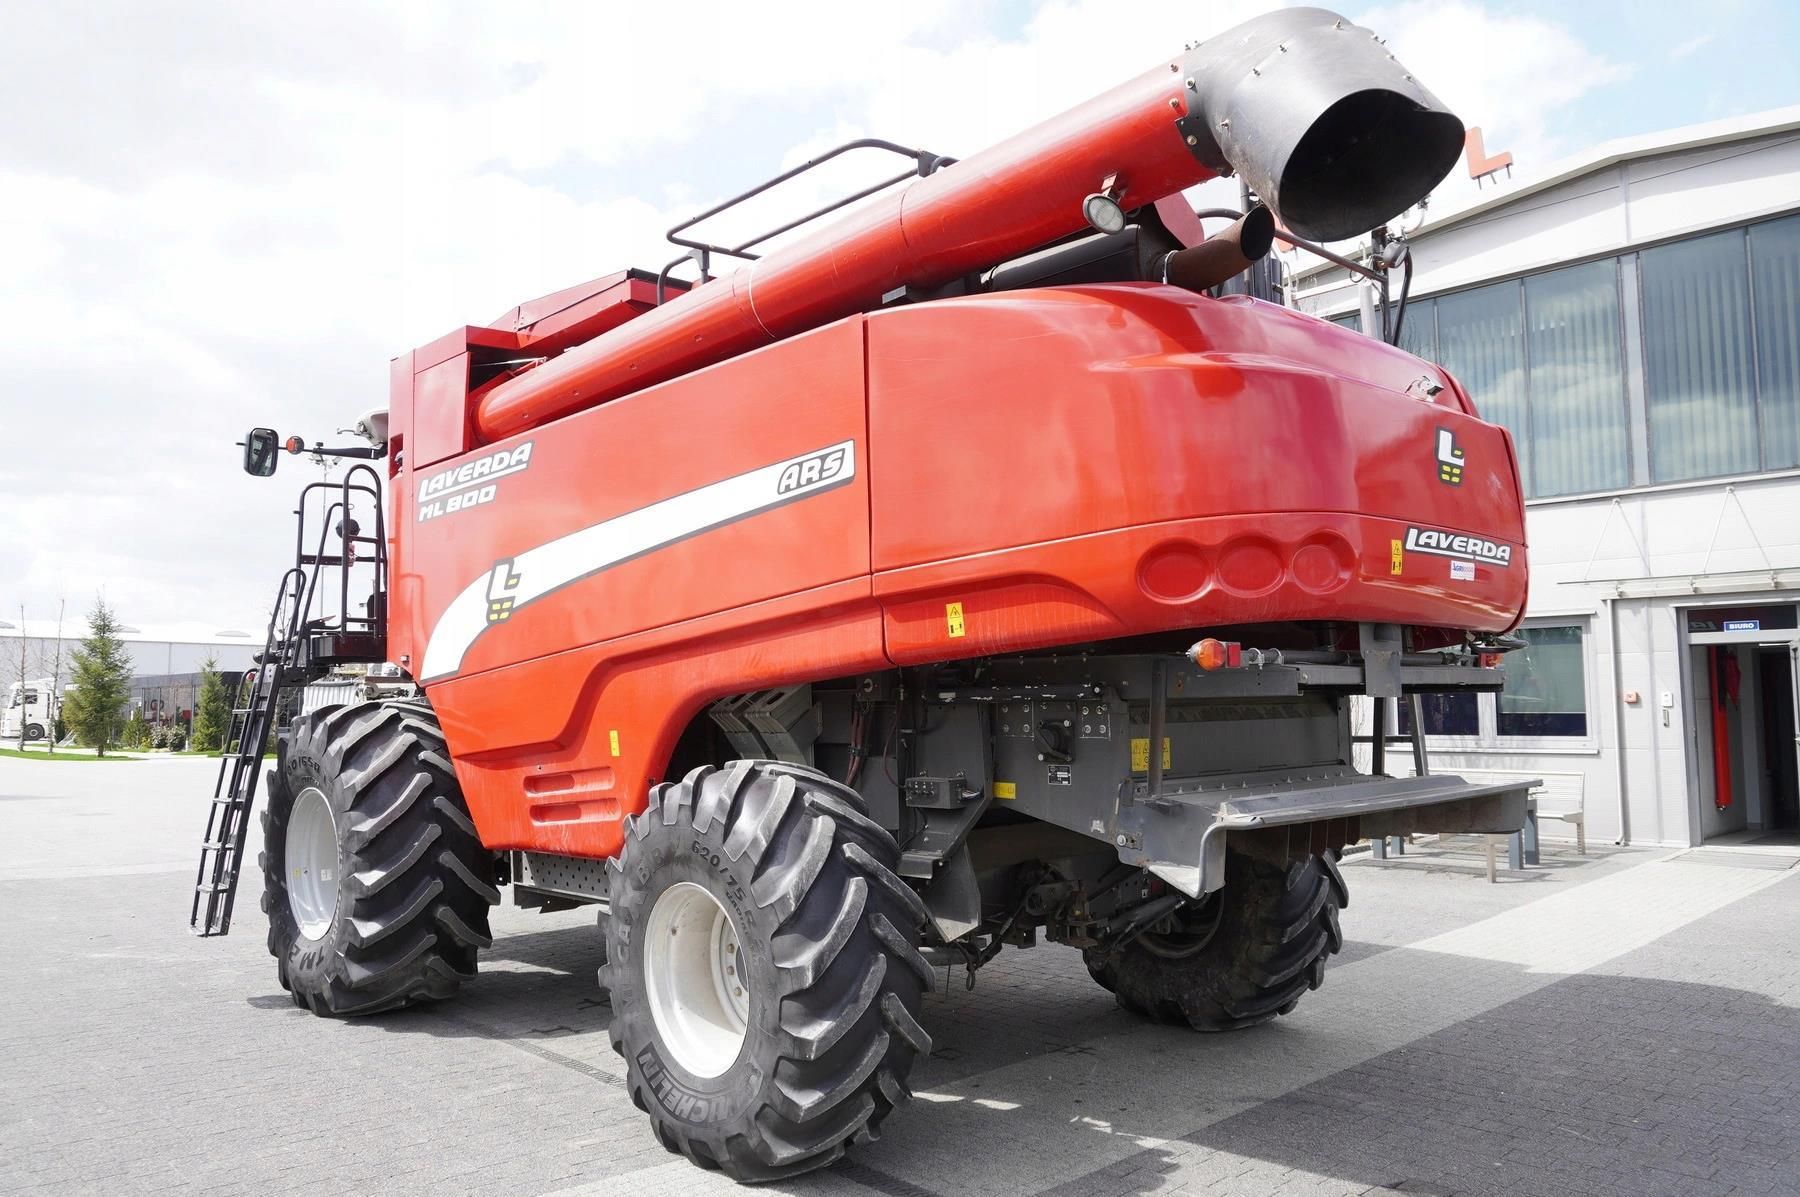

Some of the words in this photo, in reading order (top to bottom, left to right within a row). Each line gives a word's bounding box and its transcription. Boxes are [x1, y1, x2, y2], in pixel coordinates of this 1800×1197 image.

[418, 442, 532, 503] LAVERDA
[778, 449, 844, 494] ARS
[446, 485, 496, 513] 800
[1405, 528, 1511, 566] LAVERDA
